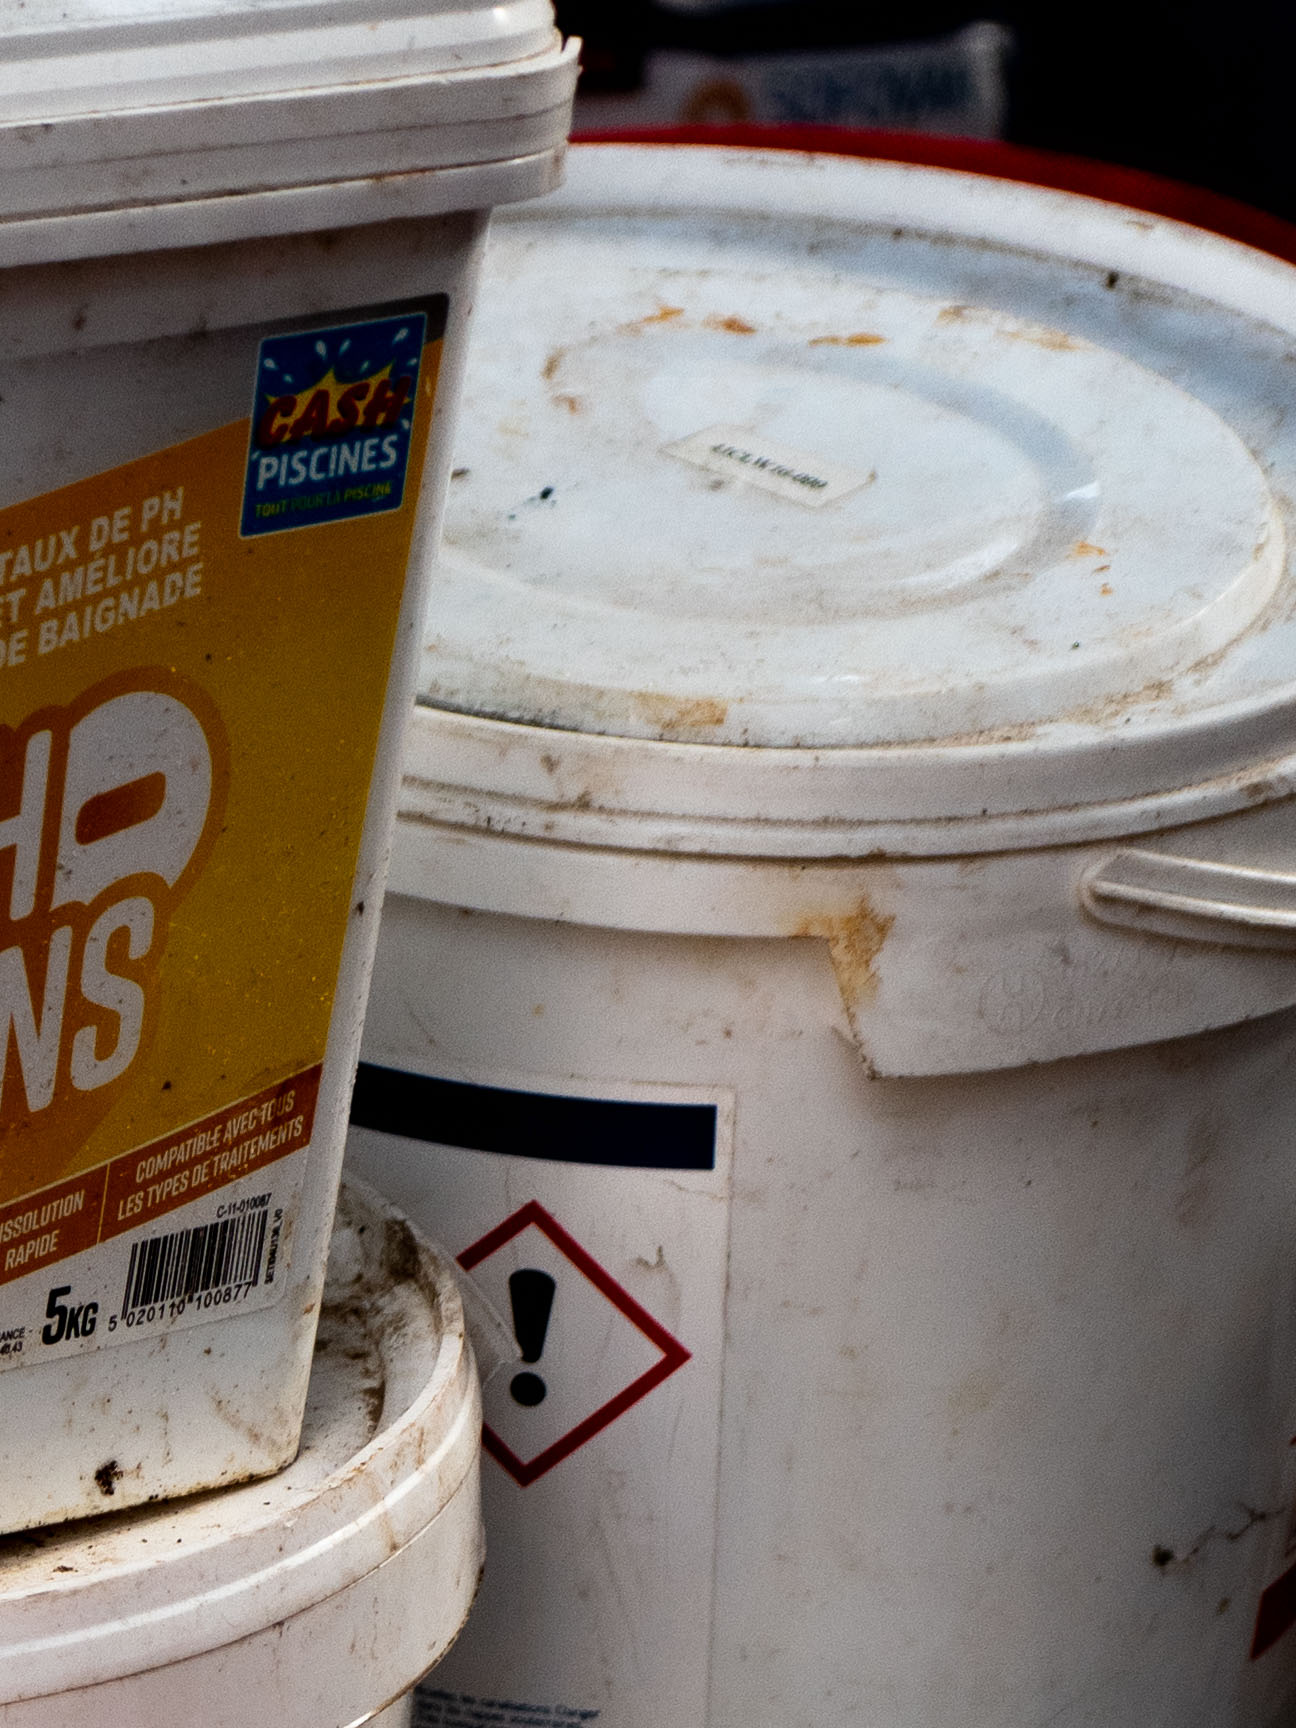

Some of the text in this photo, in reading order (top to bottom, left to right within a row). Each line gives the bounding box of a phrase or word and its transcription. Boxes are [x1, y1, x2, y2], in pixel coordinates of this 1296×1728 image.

[256, 376, 412, 490] CASH PISCINES
[89, 508, 132, 552] DE
[140, 487, 185, 533] PH
[38, 562, 204, 655] BAIGNADE
[117, 1115, 304, 1221] LES TYPES DE TRAITEMENTS
[136, 1125, 223, 1183] COMPATIBLE
[223, 1109, 257, 1143] AVEC
[5, 1231, 60, 1271] RAPIDE
[196, 1282, 252, 1310] 100877
